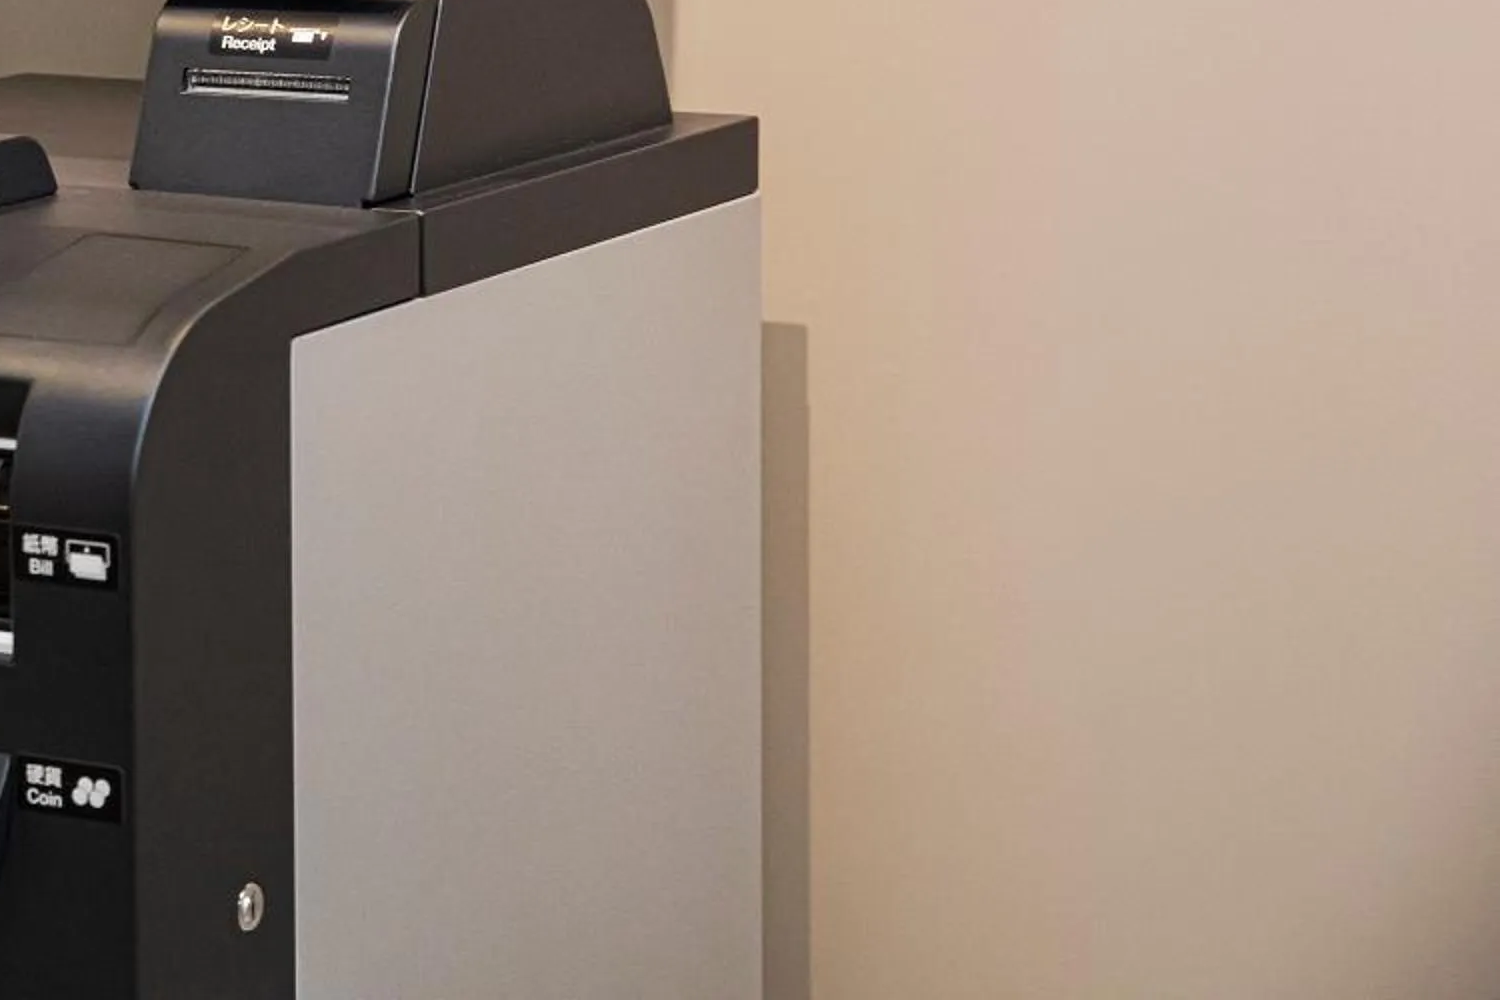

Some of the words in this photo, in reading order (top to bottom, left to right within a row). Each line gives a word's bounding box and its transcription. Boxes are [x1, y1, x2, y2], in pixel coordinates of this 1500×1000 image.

[220, 15, 287, 35] レシート
[220, 35, 277, 54] Receipt
[28, 557, 54, 577] Bill
[26, 787, 63, 809] Coin
